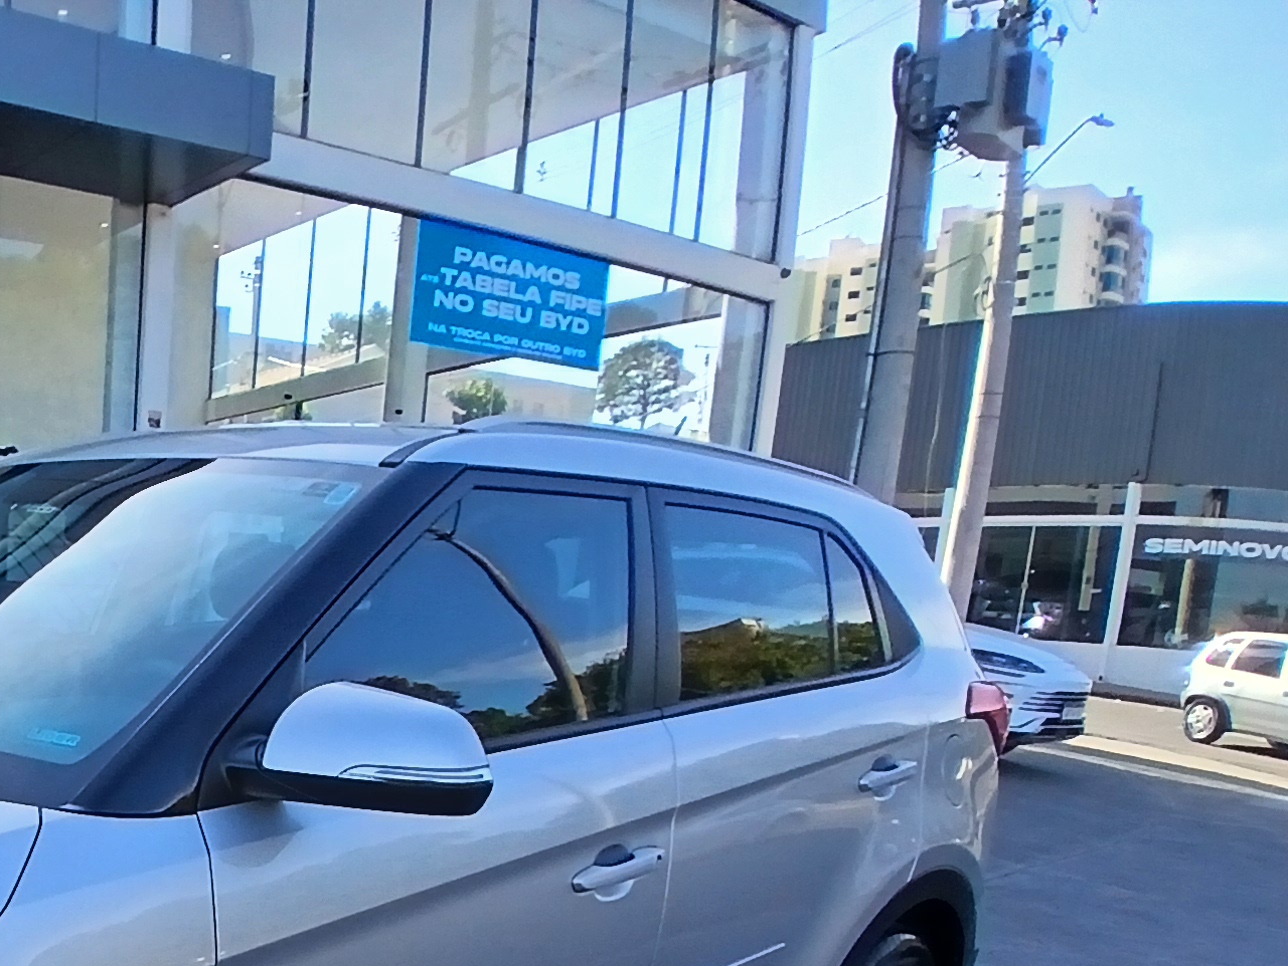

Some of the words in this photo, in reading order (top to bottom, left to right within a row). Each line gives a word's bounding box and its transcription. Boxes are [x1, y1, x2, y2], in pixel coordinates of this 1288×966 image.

[453, 246, 581, 290] PAGAMOS
[433, 288, 475, 313] NO
[482, 299, 533, 324] SEU
[539, 310, 591, 336] BYD
[440, 267, 541, 305] TABELA
[549, 289, 603, 317] FIPE
[428, 322, 447, 334] NA
[449, 325, 491, 342] TROCA
[493, 333, 518, 346] POR
[521, 338, 561, 354] OUTRO
[563, 346, 587, 359] BYD
[1143, 537, 1288, 561] SEMINOV
